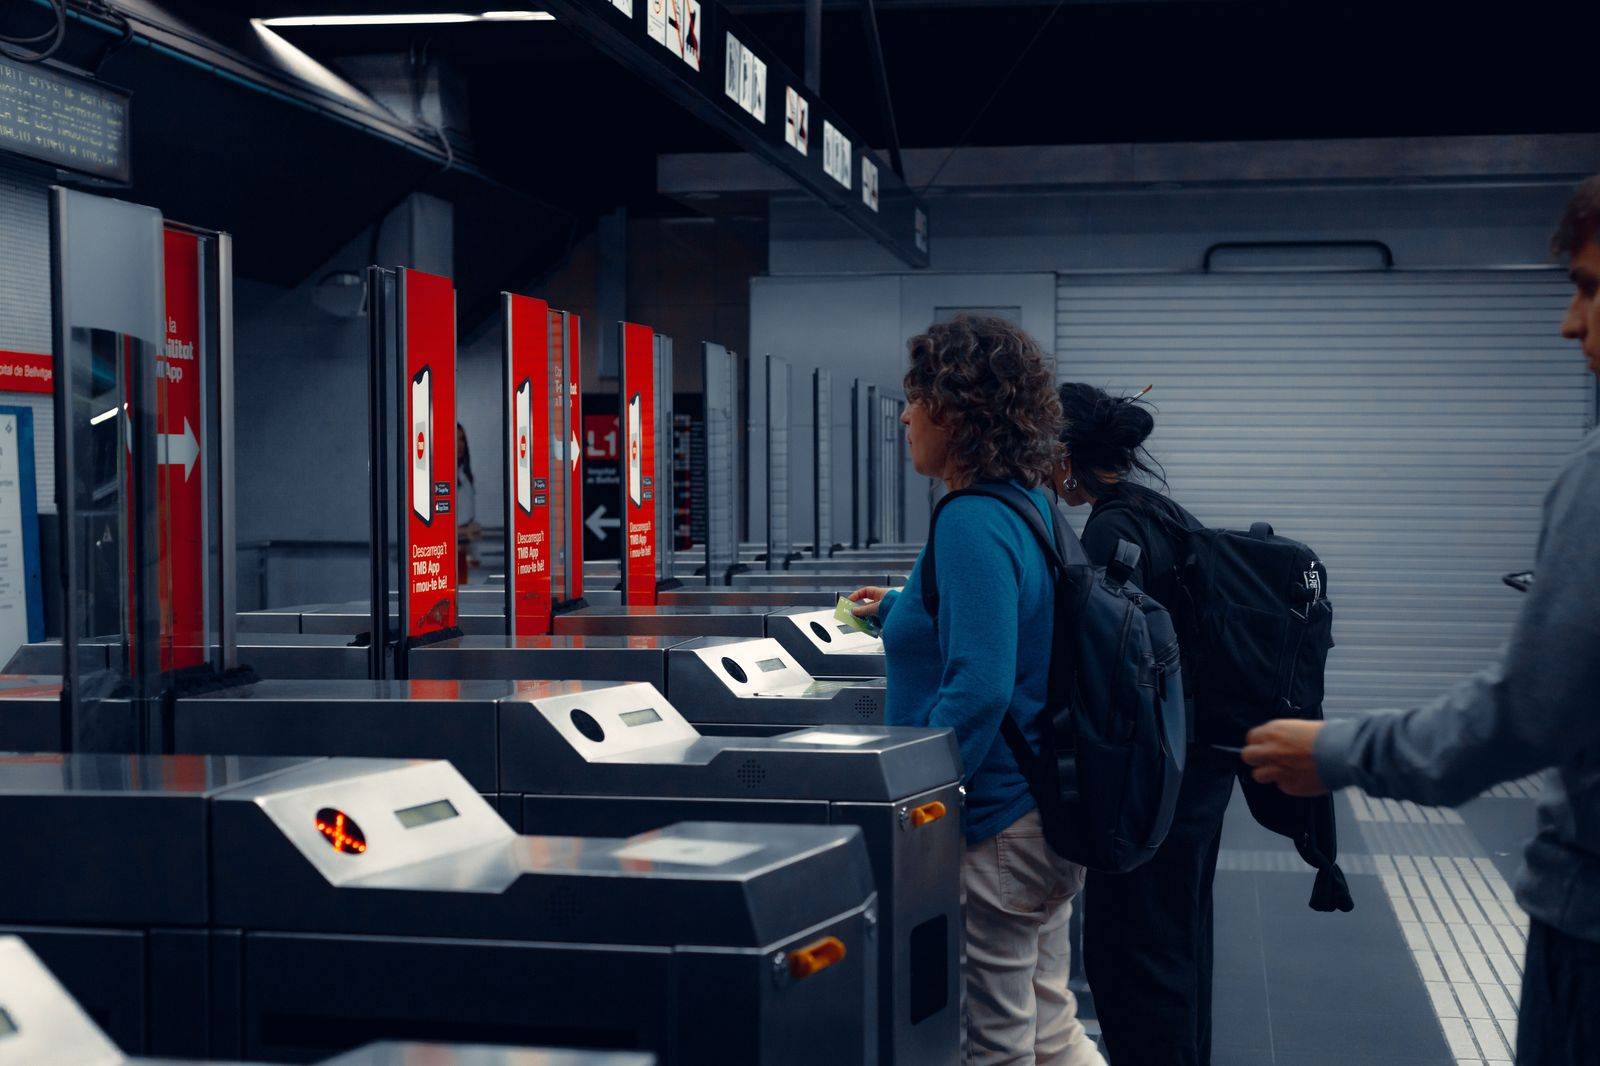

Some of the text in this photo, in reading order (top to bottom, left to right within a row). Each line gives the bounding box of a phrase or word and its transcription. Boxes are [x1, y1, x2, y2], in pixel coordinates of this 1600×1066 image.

[168, 316, 177, 334] la
[13, 364, 24, 377] de
[165, 361, 183, 383] App
[587, 430, 616, 457] L1
[517, 530, 544, 545] Descarrega't
[412, 541, 447, 558] Descarrega't
[517, 546, 539, 560] TMB App
[412, 560, 440, 576] TMB App
[520, 561, 536, 574] mou-te
[416, 577, 438, 593] mou-te
[438, 575, 448, 589] bé!
